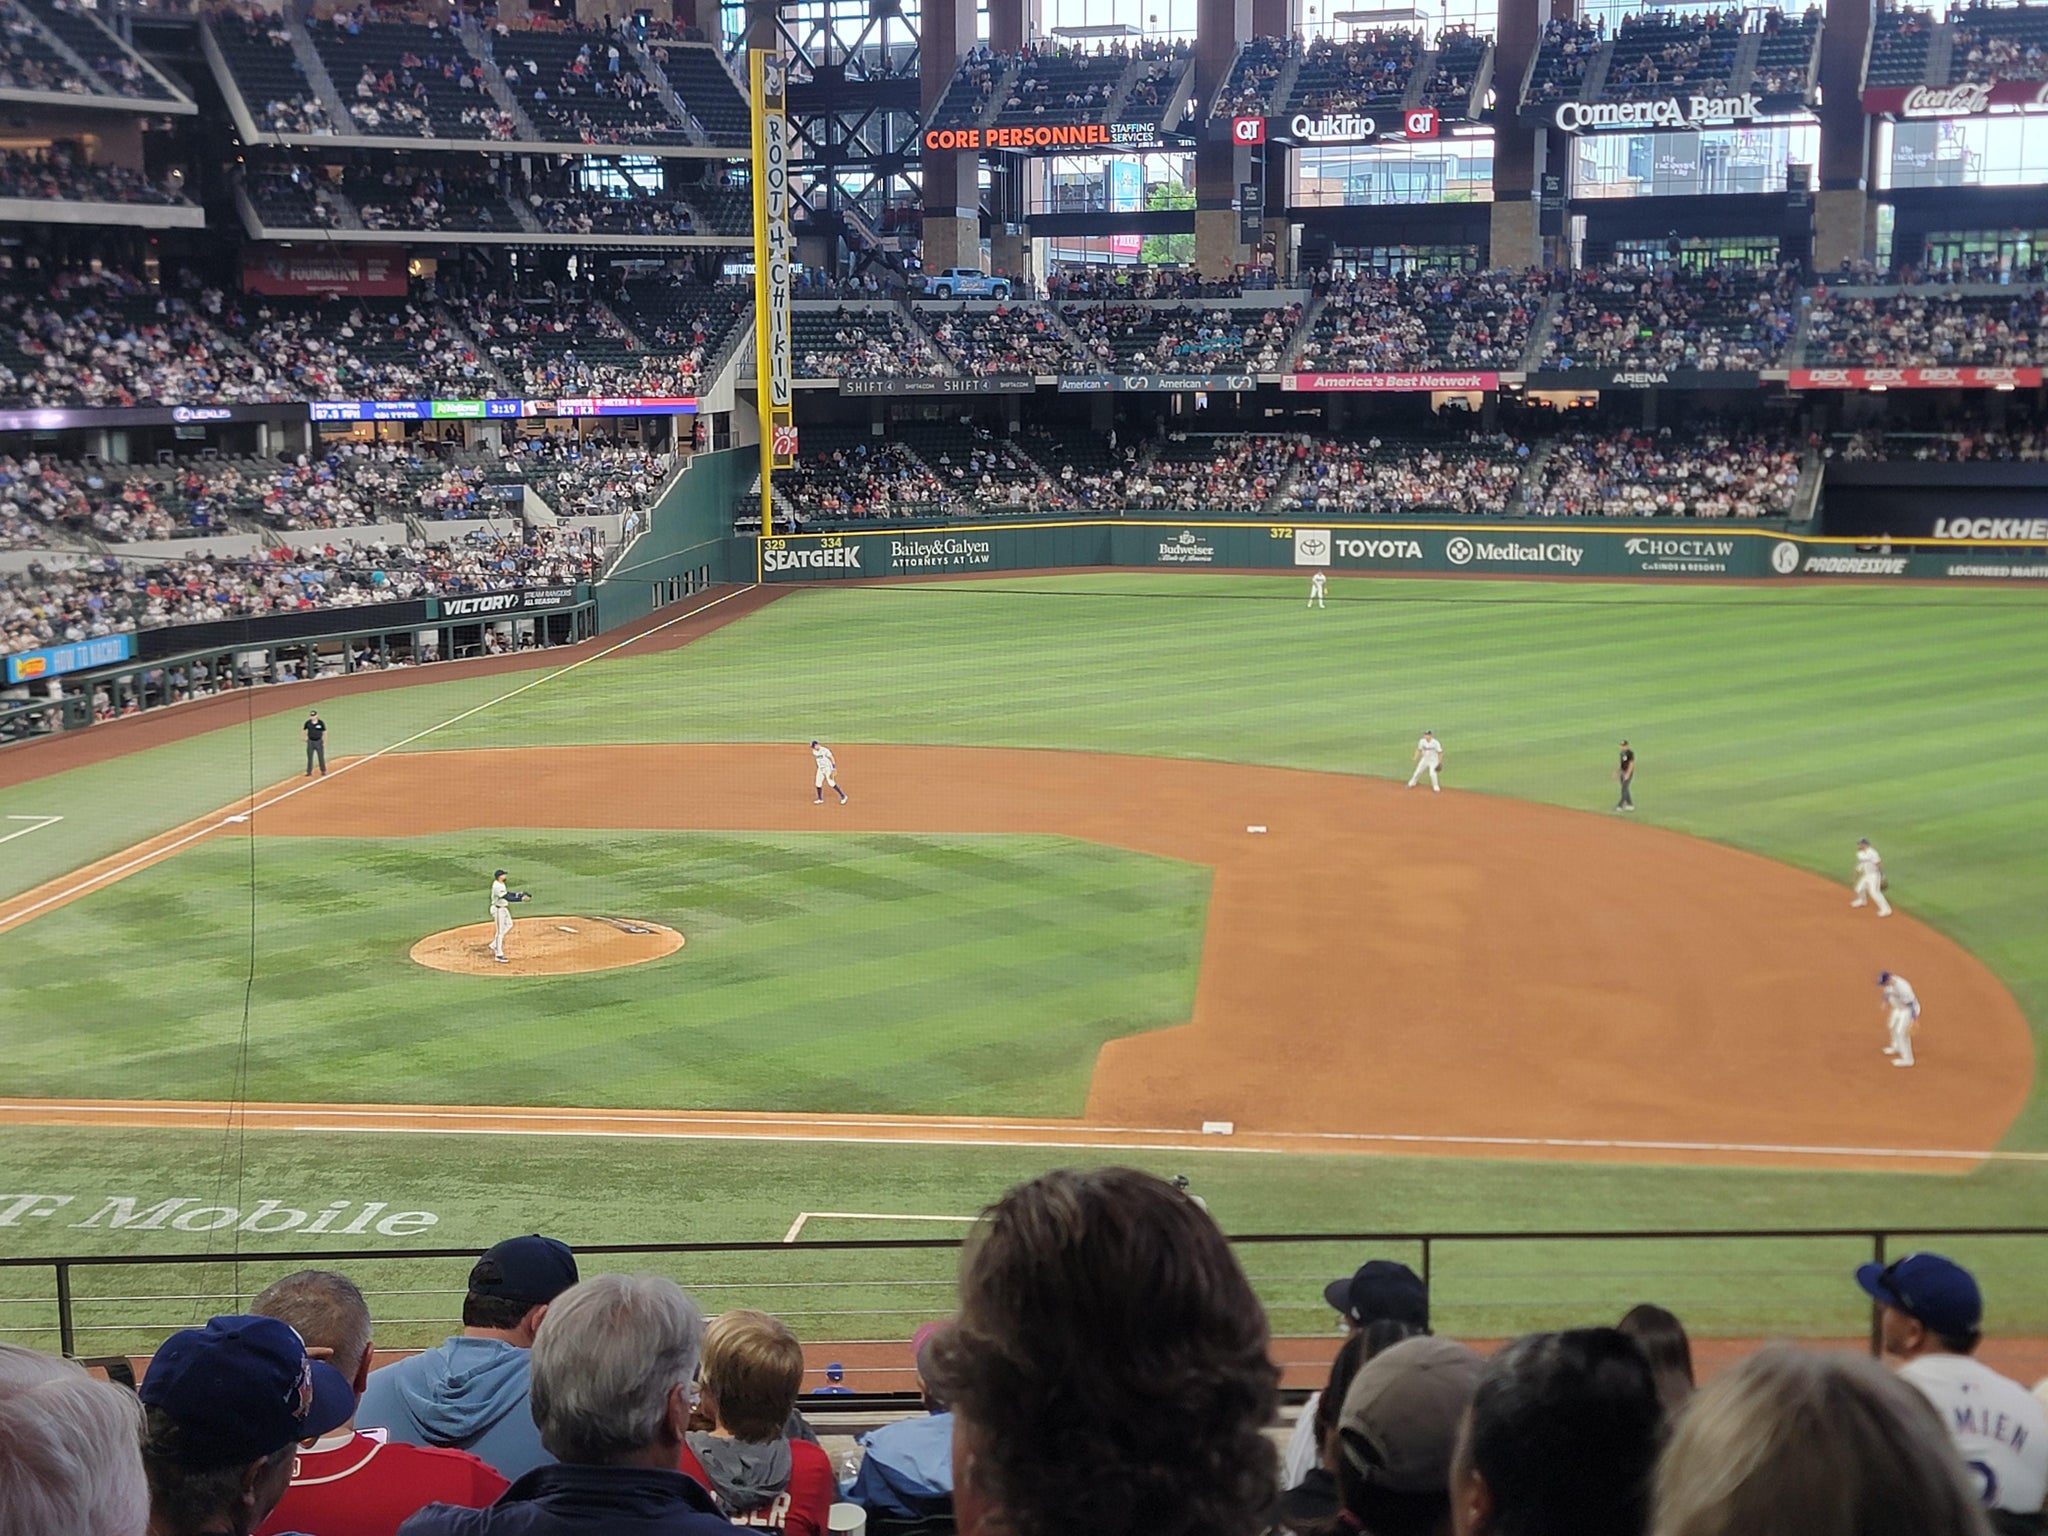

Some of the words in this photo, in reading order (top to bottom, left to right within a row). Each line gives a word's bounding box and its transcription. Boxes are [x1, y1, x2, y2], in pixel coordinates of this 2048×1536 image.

[1689, 92, 1763, 121] Bank
[1110, 122, 1155, 134] STAFFING
[1291, 113, 1376, 138] QuikTrip
[1408, 113, 1434, 134] QT
[1236, 120, 1260, 141] QT
[926, 130, 980, 150] CORE
[986, 124, 1110, 148] PERSONNEL
[1111, 132, 1154, 143] SERVICES
[769, 119, 784, 213] ROOT
[770, 228, 785, 250] 4
[771, 263, 788, 400] CHIKIN
[1612, 373, 1669, 384] ARENA
[1809, 370, 1850, 381] DEX
[1864, 369, 1904, 381] DEX
[1919, 369, 1959, 381] DEX
[1975, 368, 2016, 380] DEX
[1061, 380, 1101, 390] American
[1158, 379, 1201, 389] American
[1314, 375, 1384, 387] America's
[1386, 375, 1417, 387] Best
[1419, 374, 1482, 387] Network
[190, 408, 232, 420] LEXUS
[491, 404, 516, 414] 3:19
[1270, 528, 1293, 539] 372
[1934, 518, 2048, 540] LOCKHE
[764, 540, 786, 550] 329
[820, 537, 842, 548] 334
[1635, 538, 1734, 556] CHOCTAW
[1159, 543, 1214, 555] Budweiser
[1336, 539, 1423, 559] TOYOTA
[1476, 542, 1545, 562] Medical
[1546, 543, 1584, 567] City
[763, 546, 861, 572] SEATGEEK
[892, 557, 948, 567] ATTORNEYS
[953, 556, 965, 565] AT
[970, 554, 990, 564] LAW
[1642, 562, 1679, 572] CASINOS
[1688, 563, 1726, 572] RESORTS
[1804, 556, 1909, 575] PROGRESSIVE
[1948, 566, 2010, 577] LOCKHEED
[524, 590, 545, 599] STREAM
[545, 589, 572, 598] RANGERS
[443, 594, 514, 616] VICTORY
[524, 599, 534, 607] ALL
[534, 597, 561, 605] SEASON
